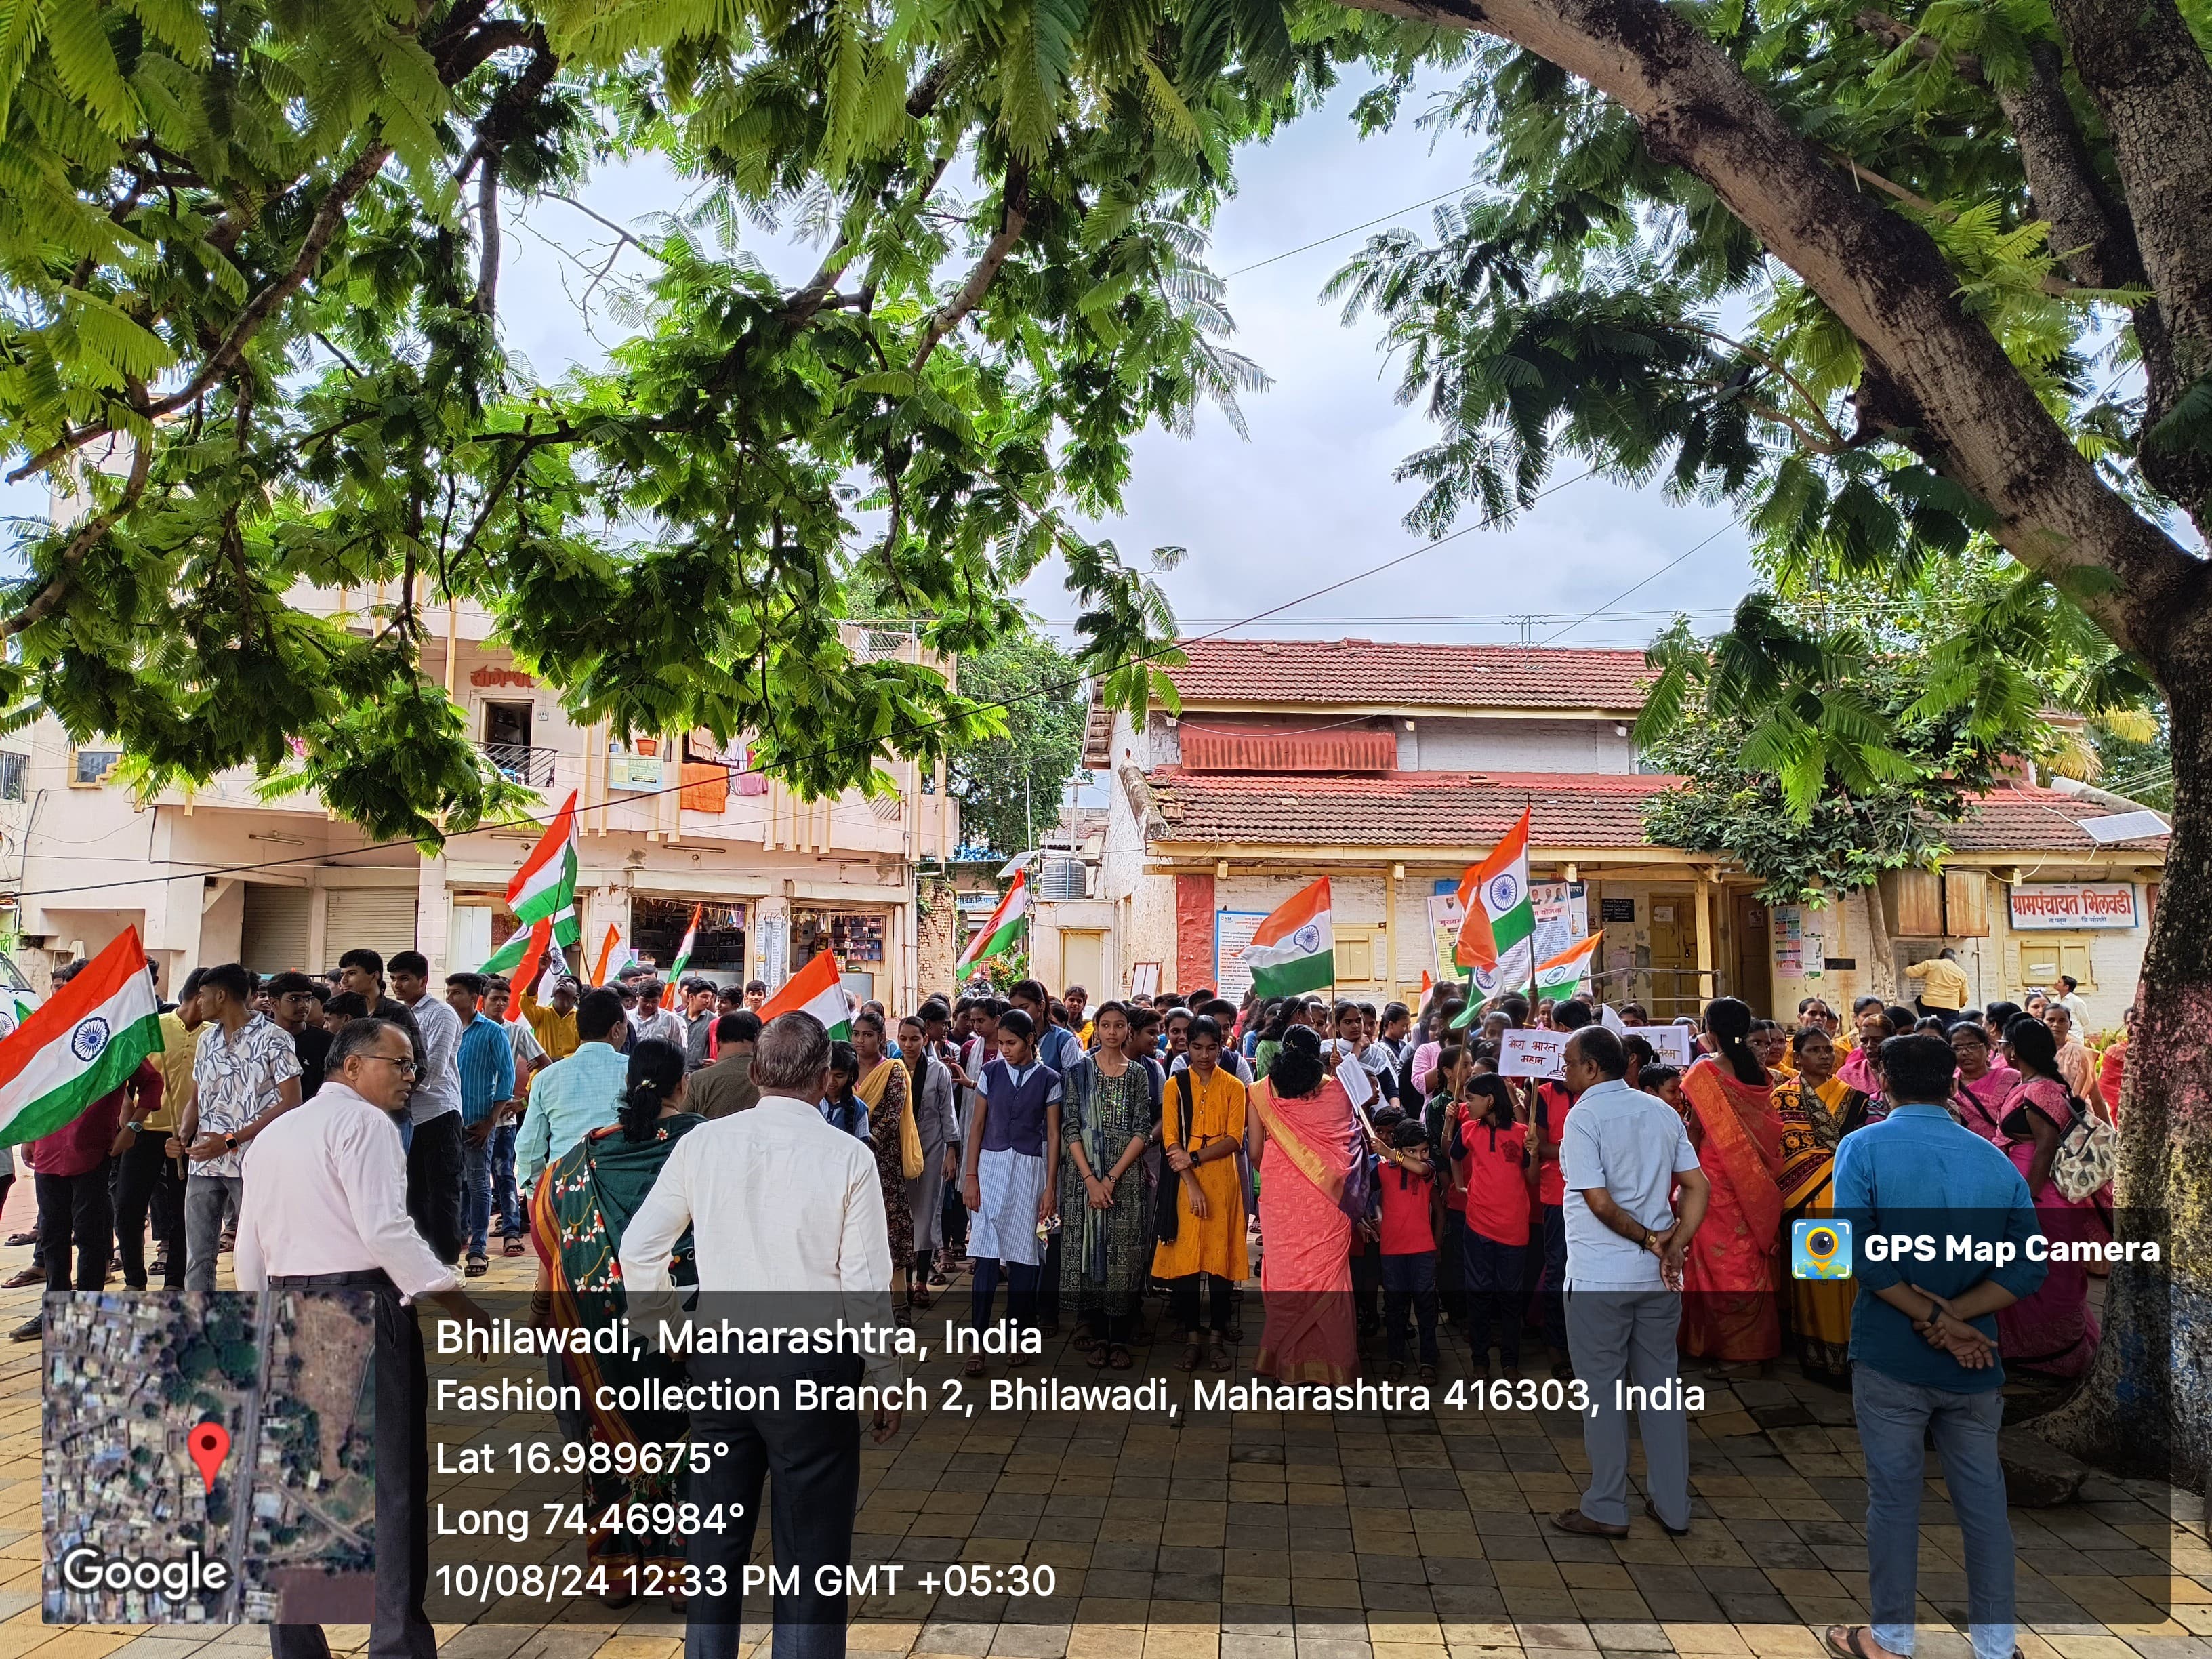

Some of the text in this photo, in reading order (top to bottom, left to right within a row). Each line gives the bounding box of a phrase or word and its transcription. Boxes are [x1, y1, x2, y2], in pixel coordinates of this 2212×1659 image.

[2012, 889, 2132, 916] ग्रामपंचायत भिलवडी
[1532, 1041, 1559, 1052] भारत
[1521, 1055, 1547, 1065] महान
